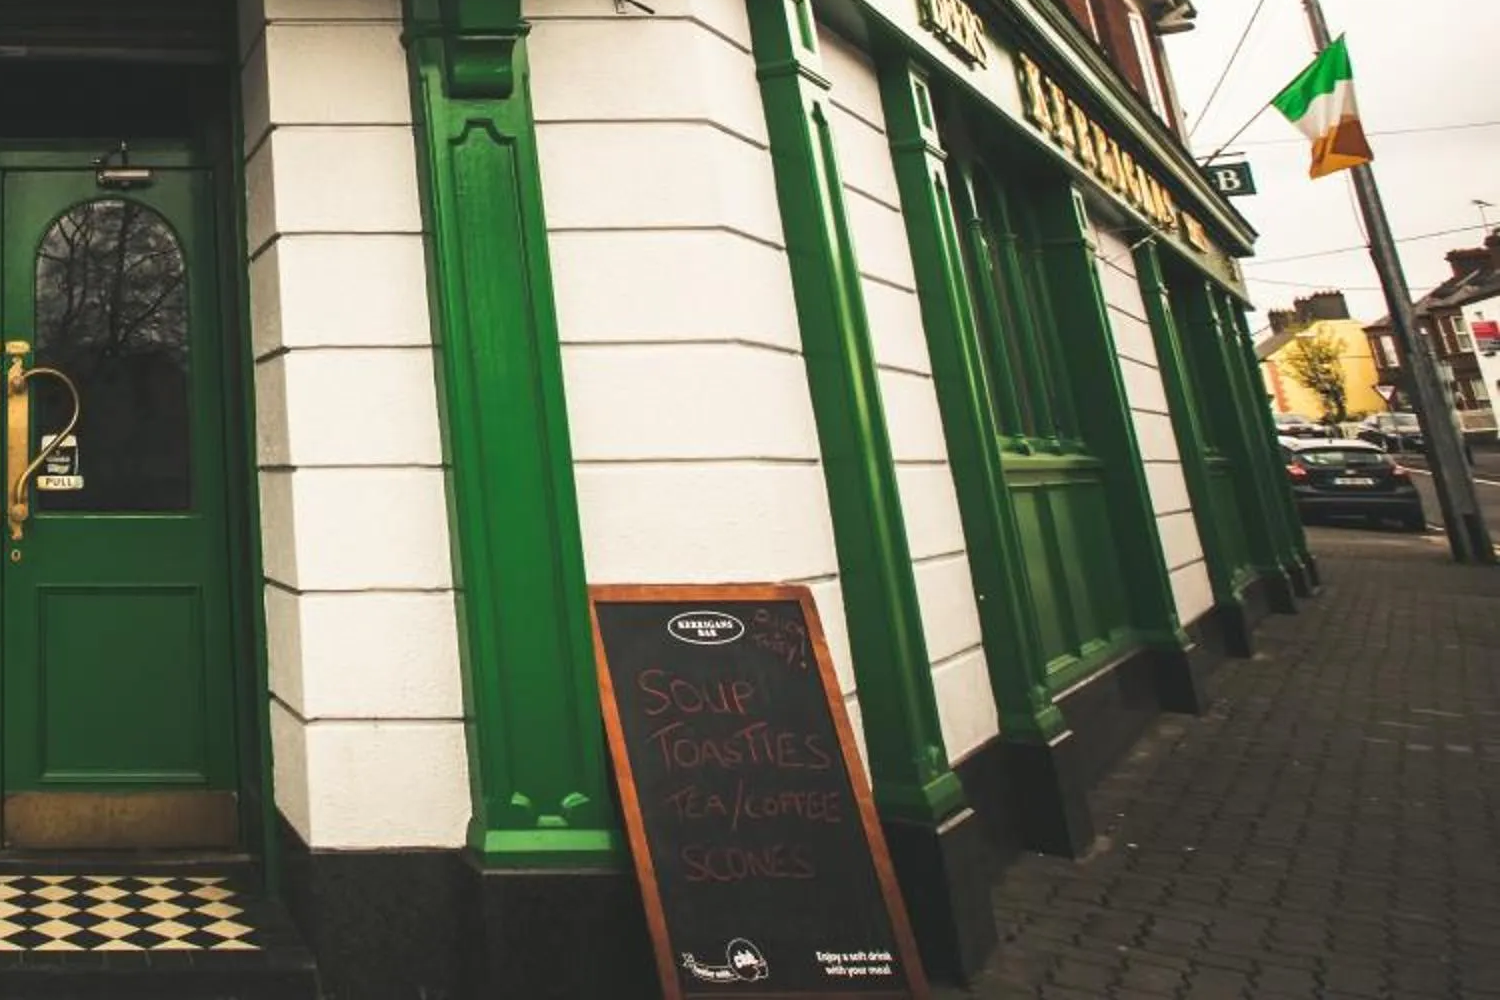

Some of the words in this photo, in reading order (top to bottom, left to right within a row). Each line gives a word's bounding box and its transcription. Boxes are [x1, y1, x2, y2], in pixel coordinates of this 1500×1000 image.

[45, 477, 72, 487] PULL
[638, 668, 755, 716] SOUP
[648, 721, 832, 773] TOASTIES
[680, 845, 816, 882] SCONES
